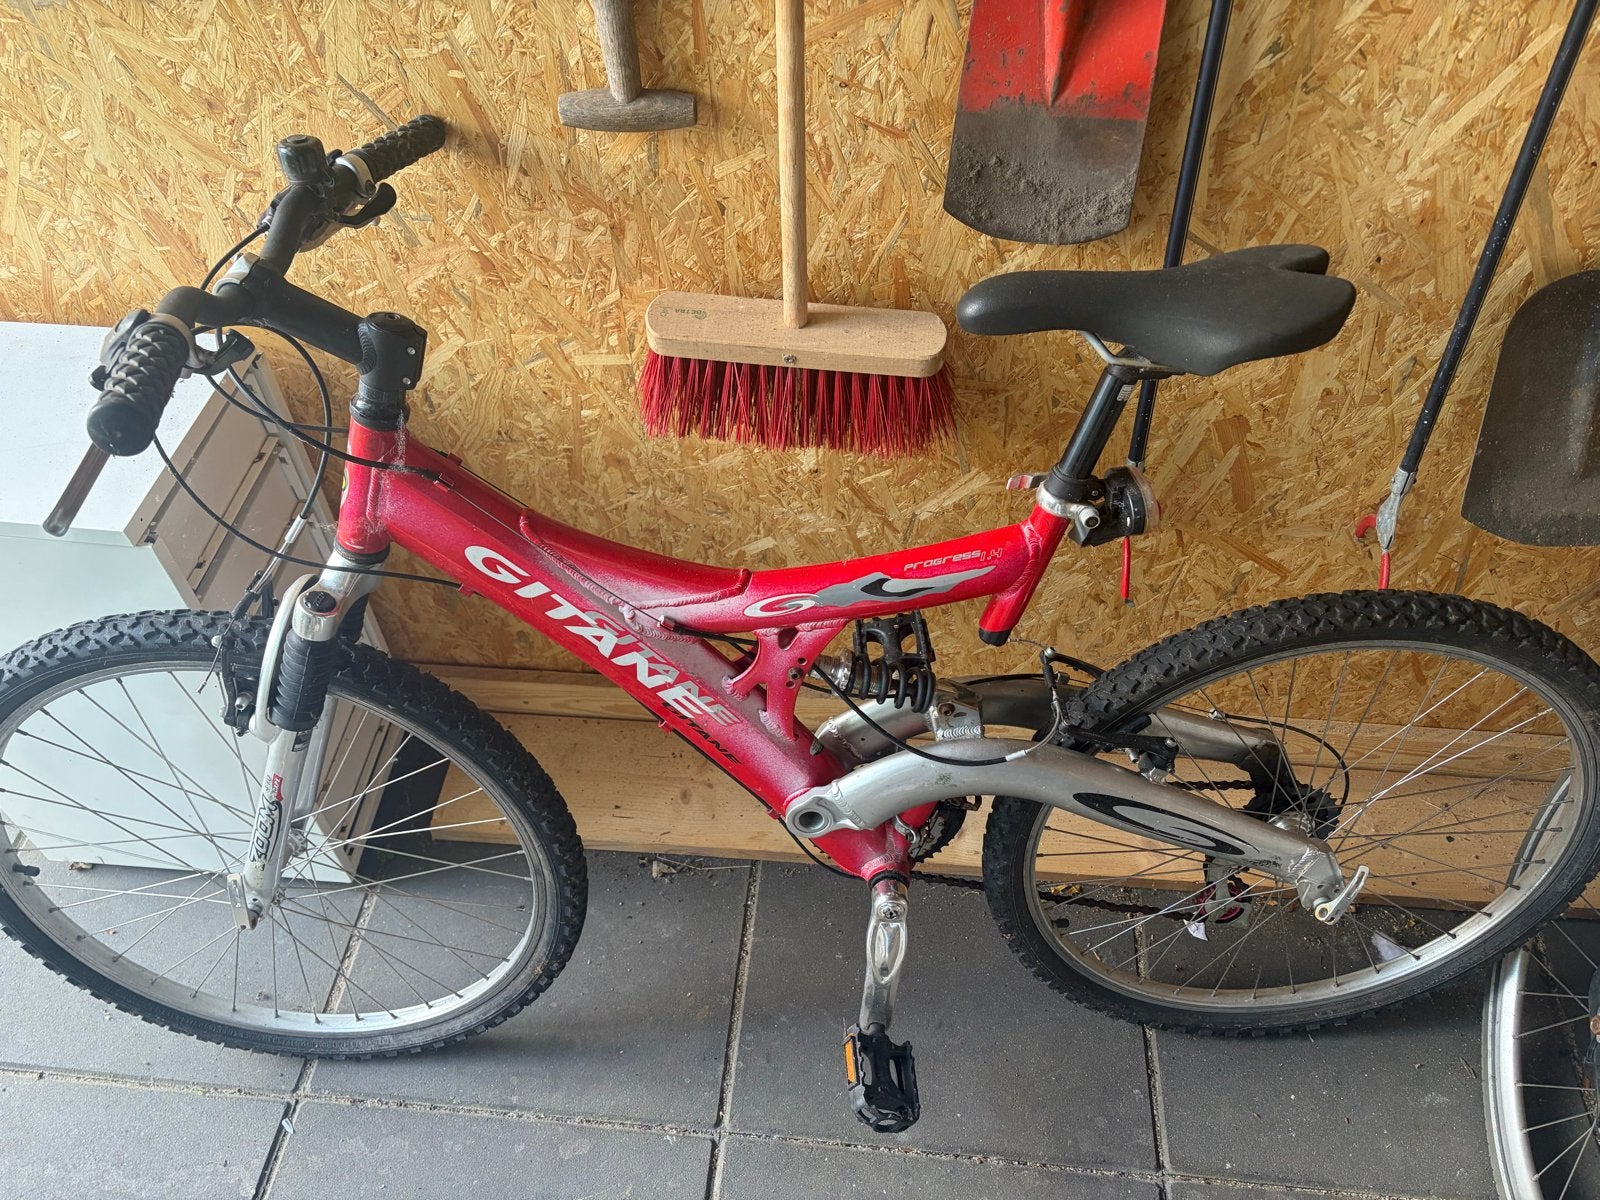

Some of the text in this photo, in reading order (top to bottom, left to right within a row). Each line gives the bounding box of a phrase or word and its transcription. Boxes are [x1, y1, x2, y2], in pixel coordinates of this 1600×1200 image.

[464, 545, 719, 719] GITANE
[584, 611, 743, 726] GITANE
[662, 702, 743, 766] GITANE
[249, 793, 279, 871] ZOOM
